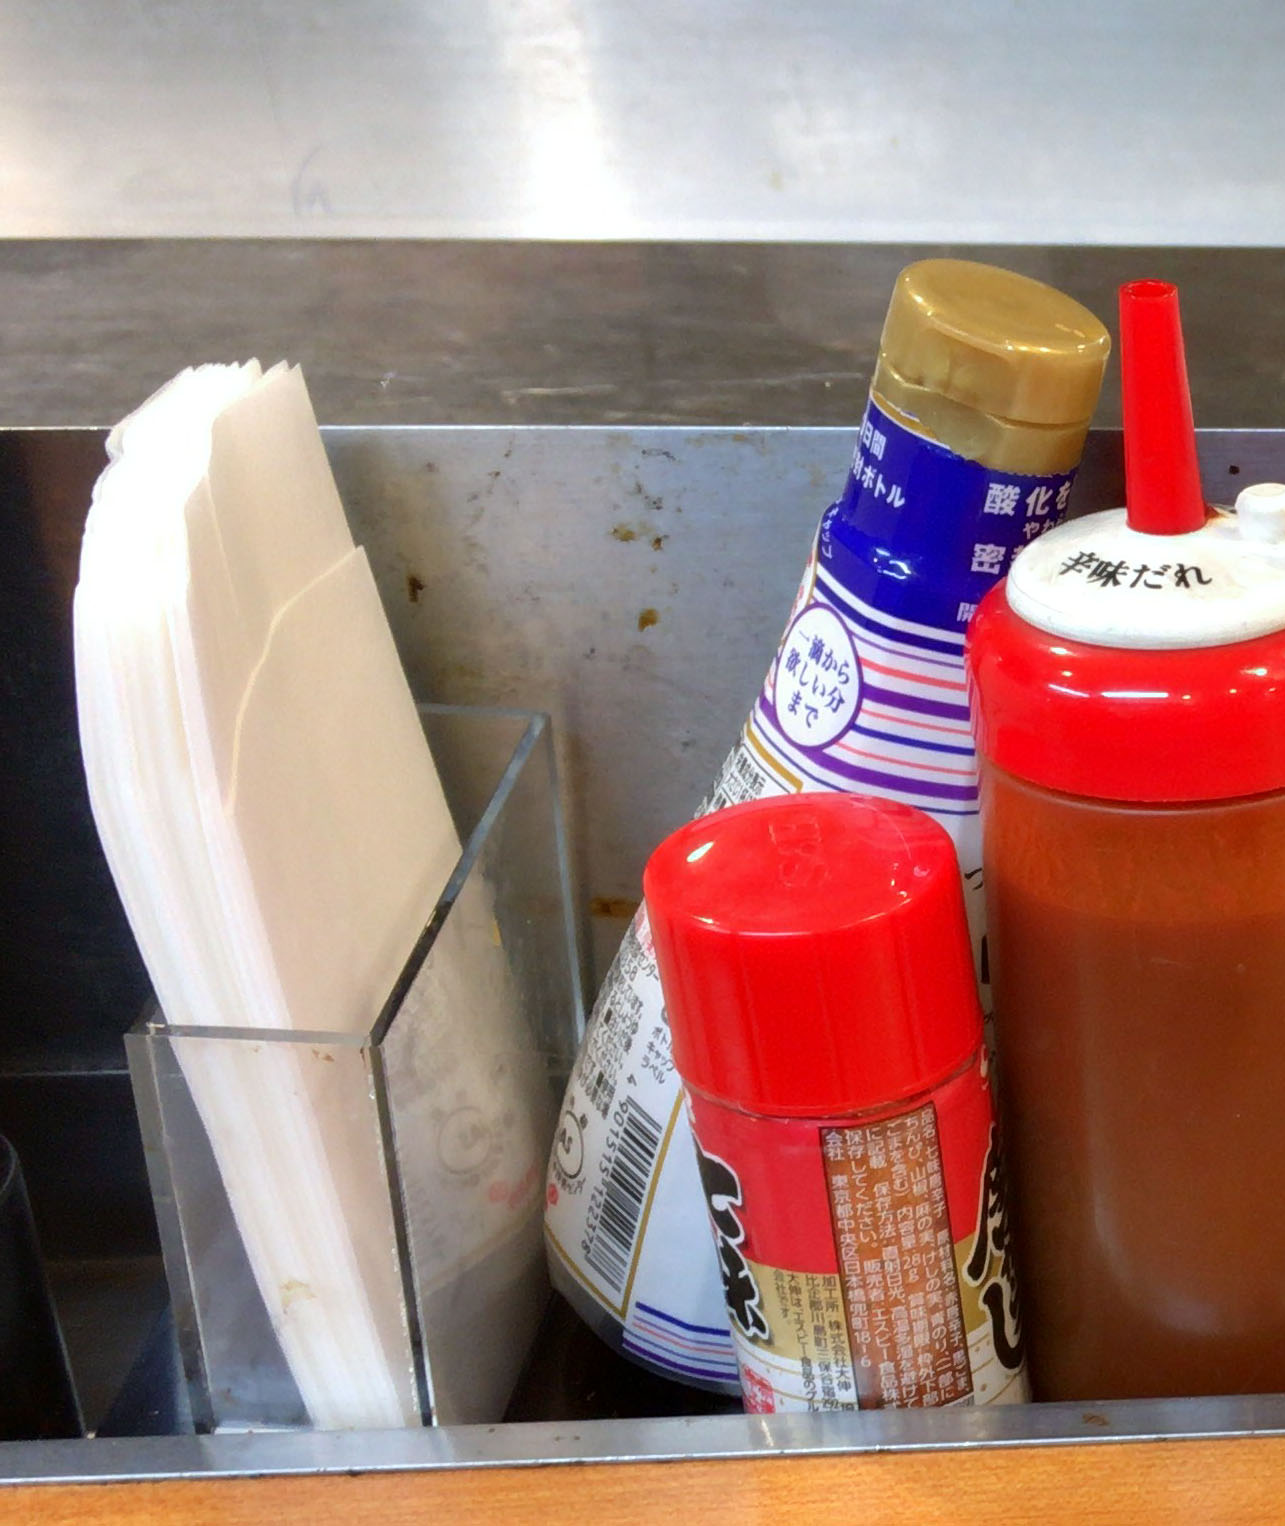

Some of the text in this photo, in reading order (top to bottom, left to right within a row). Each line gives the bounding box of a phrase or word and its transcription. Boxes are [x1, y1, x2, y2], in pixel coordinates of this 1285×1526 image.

[861, 420, 887, 461] 日間
[853, 447, 905, 508] 封ボトル
[983, 481, 1071, 516] 酸化を
[1023, 514, 1067, 539] やわ
[1059, 551, 1213, 589] 辛味だれ
[798, 630, 850, 685] 一滴から
[785, 647, 845, 713] 欲しい分
[788, 690, 819, 729] まで
[627, 1074, 638, 1087] 4
[641, 1055, 667, 1084] ラベル
[602, 1099, 628, 1184] 901515
[825, 1131, 846, 1162] 会社
[845, 1129, 879, 1248] 保存してください。
